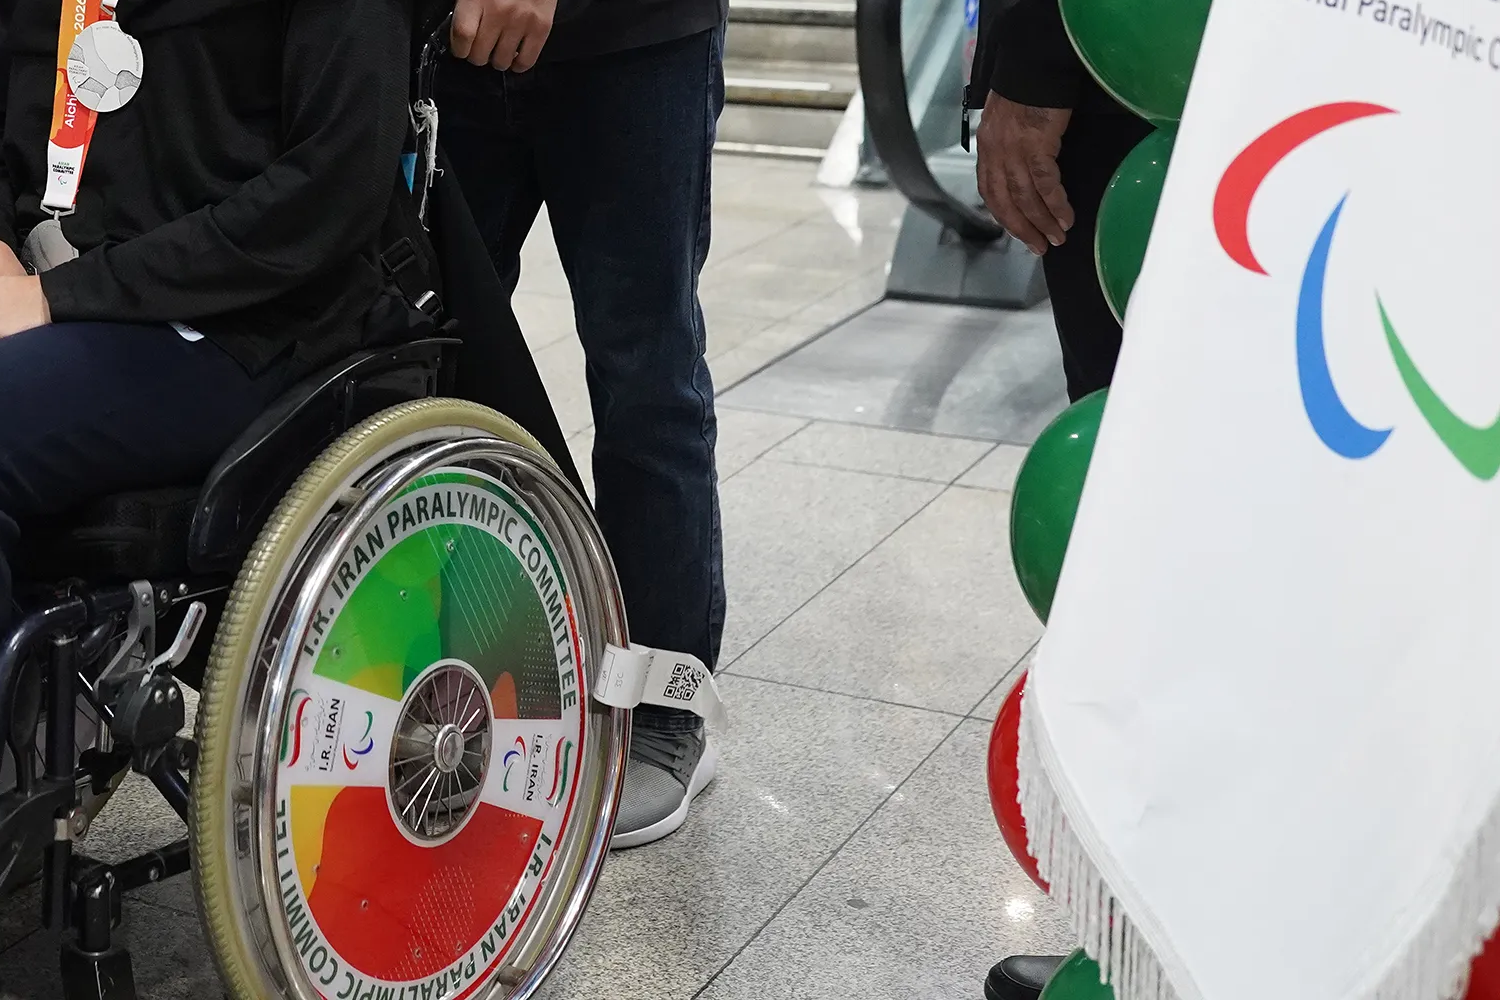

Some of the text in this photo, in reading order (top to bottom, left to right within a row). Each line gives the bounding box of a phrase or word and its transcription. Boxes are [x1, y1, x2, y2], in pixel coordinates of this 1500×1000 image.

[330, 525, 385, 600] IRAN
[386, 490, 518, 544] PARALYMPIC
[518, 533, 577, 711] COMMITTEE
[318, 698, 341, 771] I.R. IRAN
[526, 764, 539, 801] IRAN
[480, 894, 526, 965] IRAN
